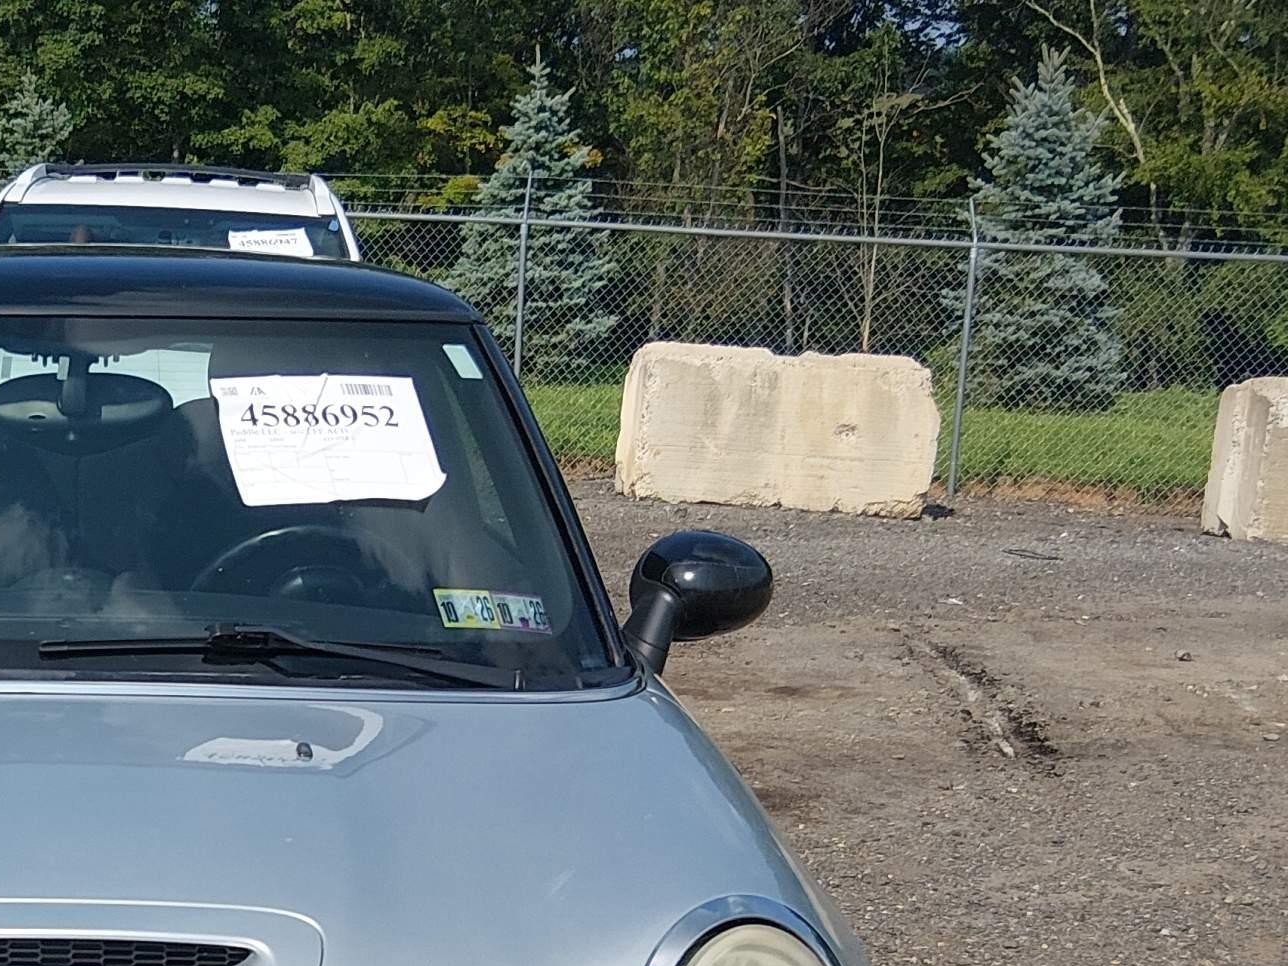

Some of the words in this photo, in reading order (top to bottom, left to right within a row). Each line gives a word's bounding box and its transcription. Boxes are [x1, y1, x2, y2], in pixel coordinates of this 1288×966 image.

[241, 403, 399, 428] 45886952
[440, 601, 459, 623] 10
[476, 596, 495, 622] 26
[497, 602, 514, 625] 10
